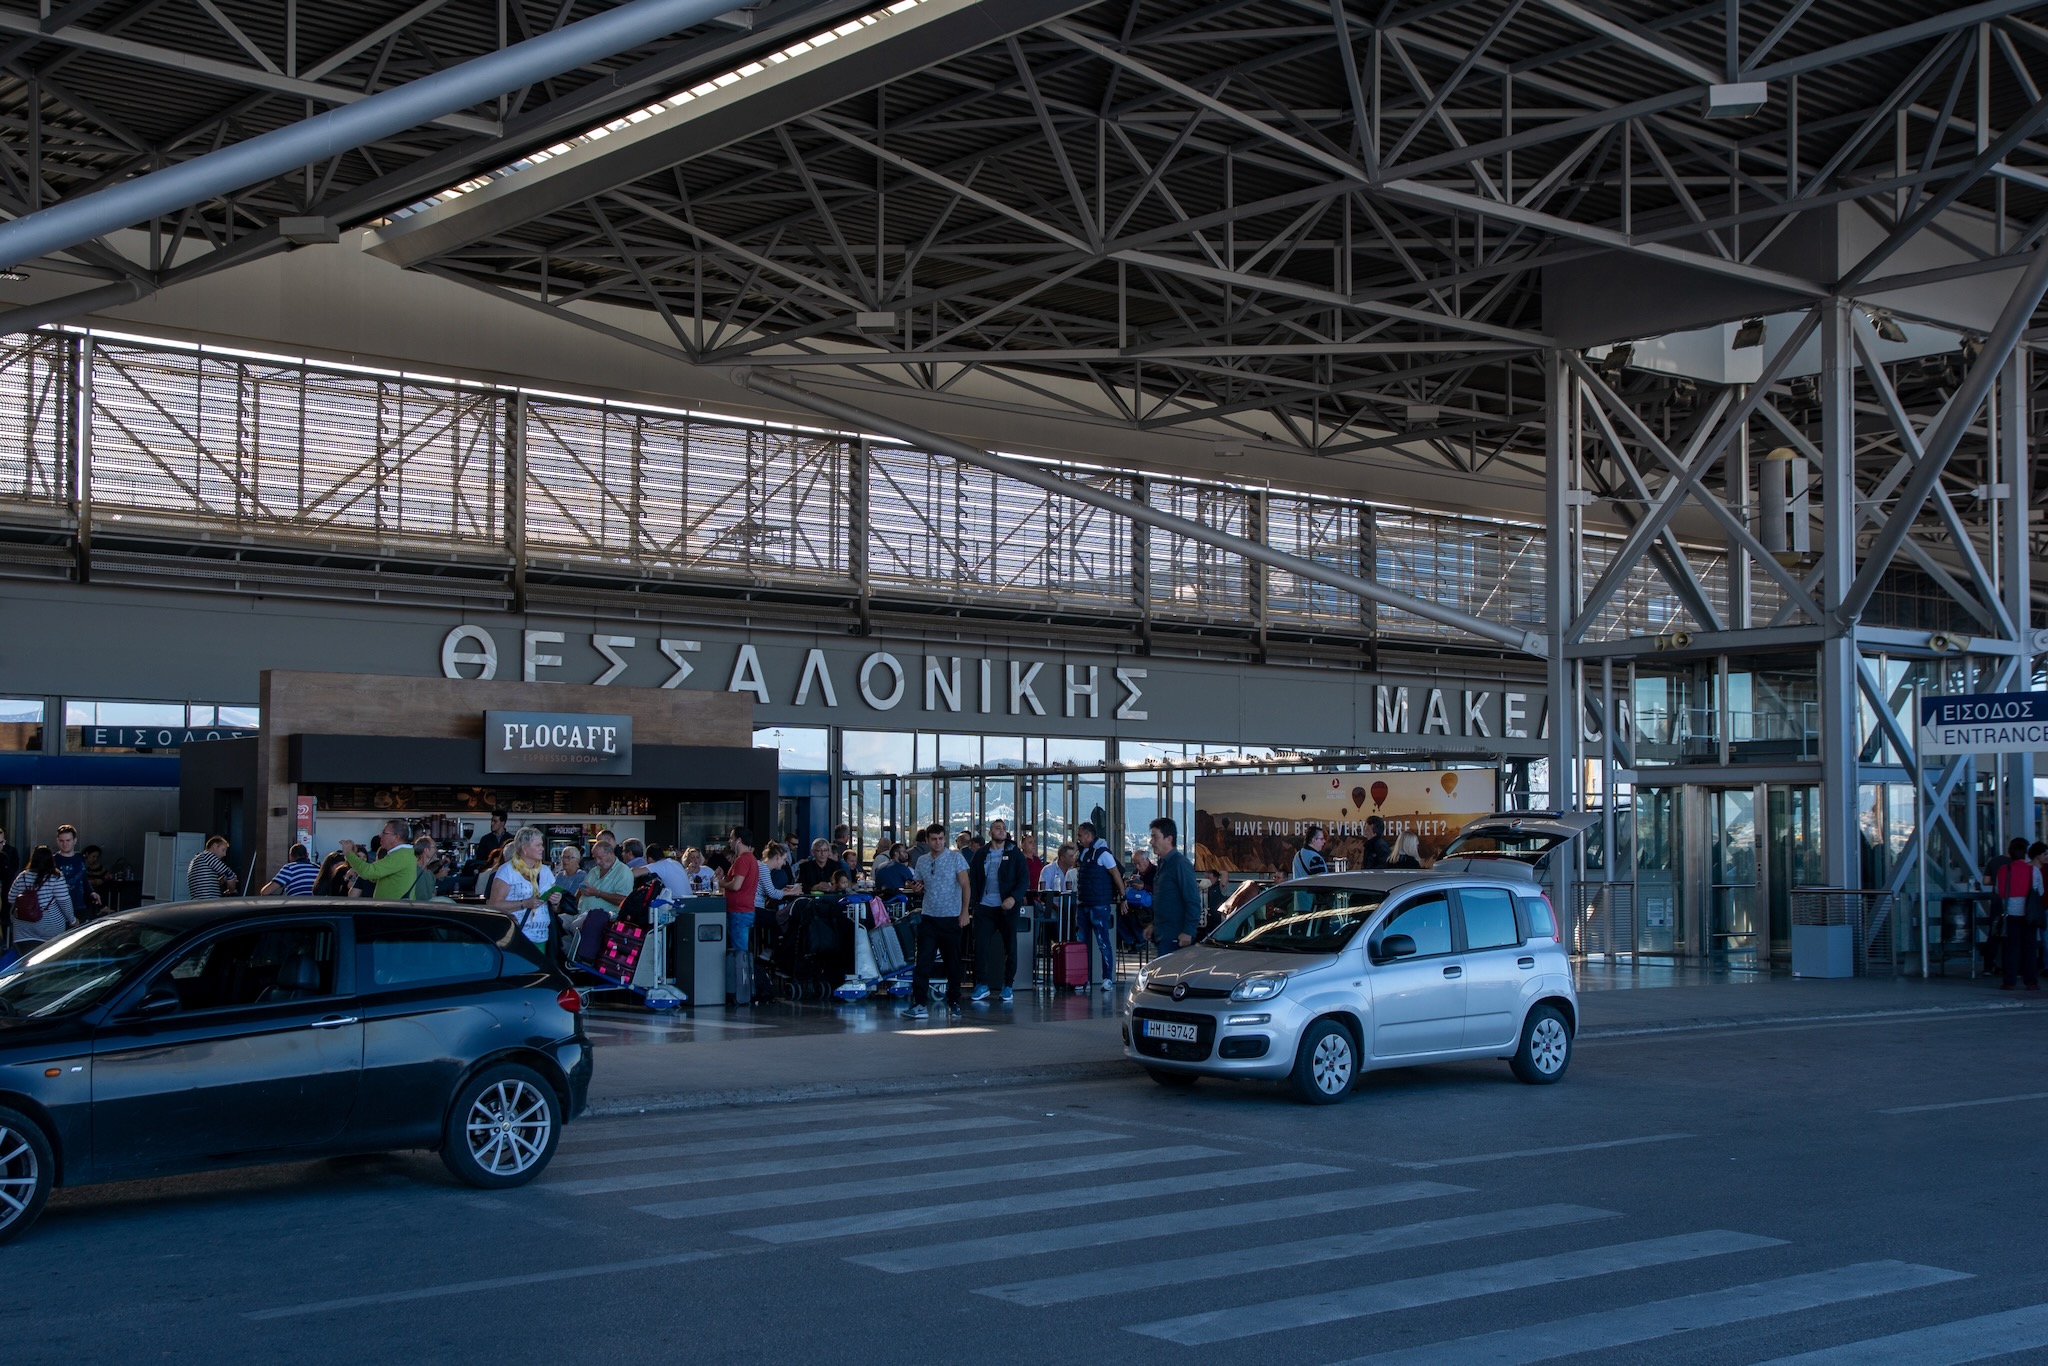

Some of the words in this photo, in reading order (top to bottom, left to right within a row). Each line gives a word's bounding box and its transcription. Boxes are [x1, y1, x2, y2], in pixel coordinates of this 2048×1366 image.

[441, 624, 1148, 721] ΘΕΣΣΑΛΟΝΙΚΗΣ
[1943, 701, 2034, 721] ΕΙΣΟΔΟΣ
[503, 723, 616, 754] FLOCAFE
[523, 753, 568, 762] ESPRESSO
[570, 754, 598, 763] ROOM
[1234, 821, 1265, 836] HAVE
[1267, 821, 1289, 836] YOU
[1416, 819, 1447, 836] YET?
